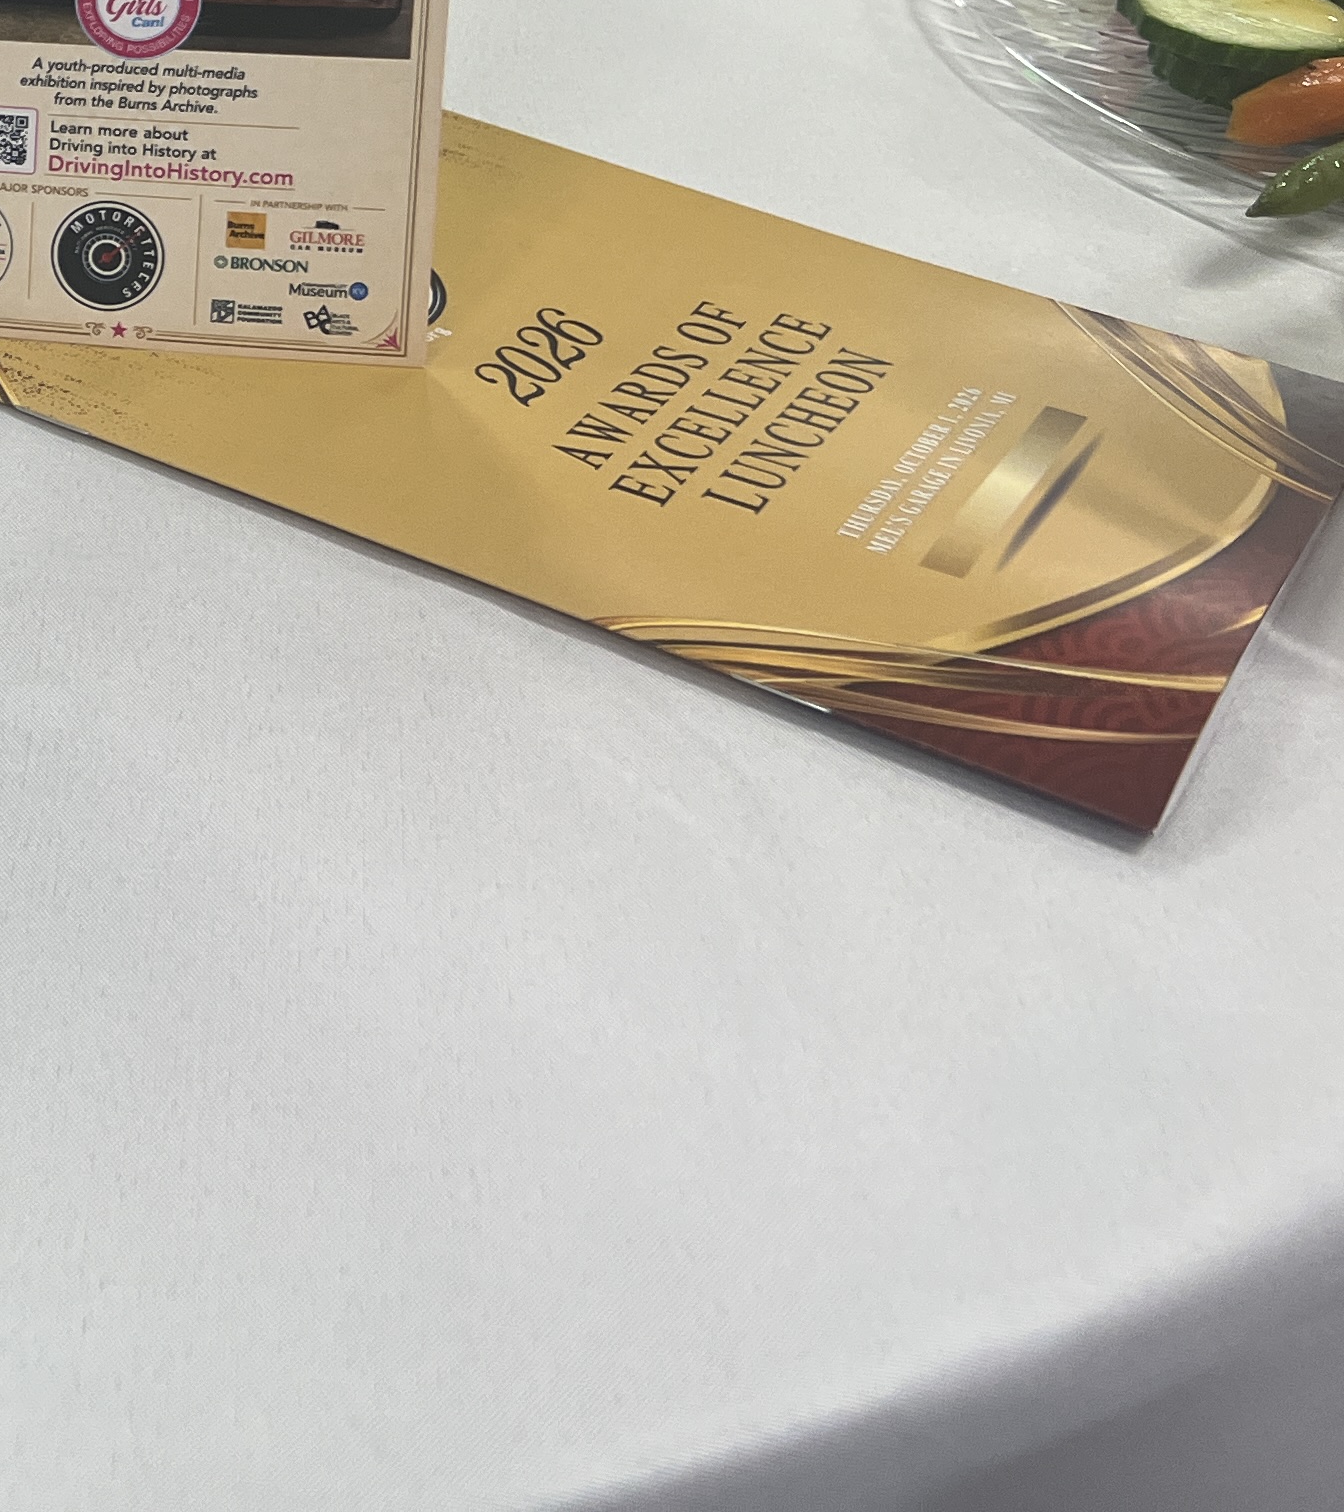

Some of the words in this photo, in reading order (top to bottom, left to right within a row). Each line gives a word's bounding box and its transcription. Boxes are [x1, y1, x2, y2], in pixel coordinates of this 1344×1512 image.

[82, 1, 124, 51] EXPLORING
[131, 16, 165, 27] Can!
[31, 57, 43, 70] A
[47, 59, 158, 75] youth-produced
[163, 64, 245, 80] multi-media
[20, 74, 85, 89] exhibition
[89, 78, 144, 94] inspired
[148, 81, 166, 97] by
[169, 82, 258, 100] photographs
[54, 93, 86, 106] from
[91, 95, 113, 108] the
[118, 97, 157, 111] Burns
[161, 99, 218, 114] Archive.
[51, 121, 92, 135] Learn
[98, 126, 137, 138] more
[143, 126, 188, 141] about
[49, 138, 103, 156] Driving
[108, 142, 137, 155] into
[142, 145, 196, 162] History
[201, 149, 217, 160] at
[48, 154, 292, 188] DrivingIntoHistory.com
[31, 185, 88, 197] SPONSORS
[263, 201, 322, 210] PARTNERSHIP
[289, 230, 365, 246] GILMORE
[230, 256, 309, 273] BRONSON
[289, 283, 347, 298] Museum
[473, 307, 605, 407] 2026
[551, 344, 709, 471] AWARDS
[674, 299, 748, 346] OF
[609, 310, 832, 508] EXCELLENCE
[701, 346, 895, 516] LUNCHEON
[893, 423, 952, 474] OCTOBER
[947, 386, 982, 412] 2026
[898, 468, 952, 516] GARAGE
[936, 455, 964, 470] IN
